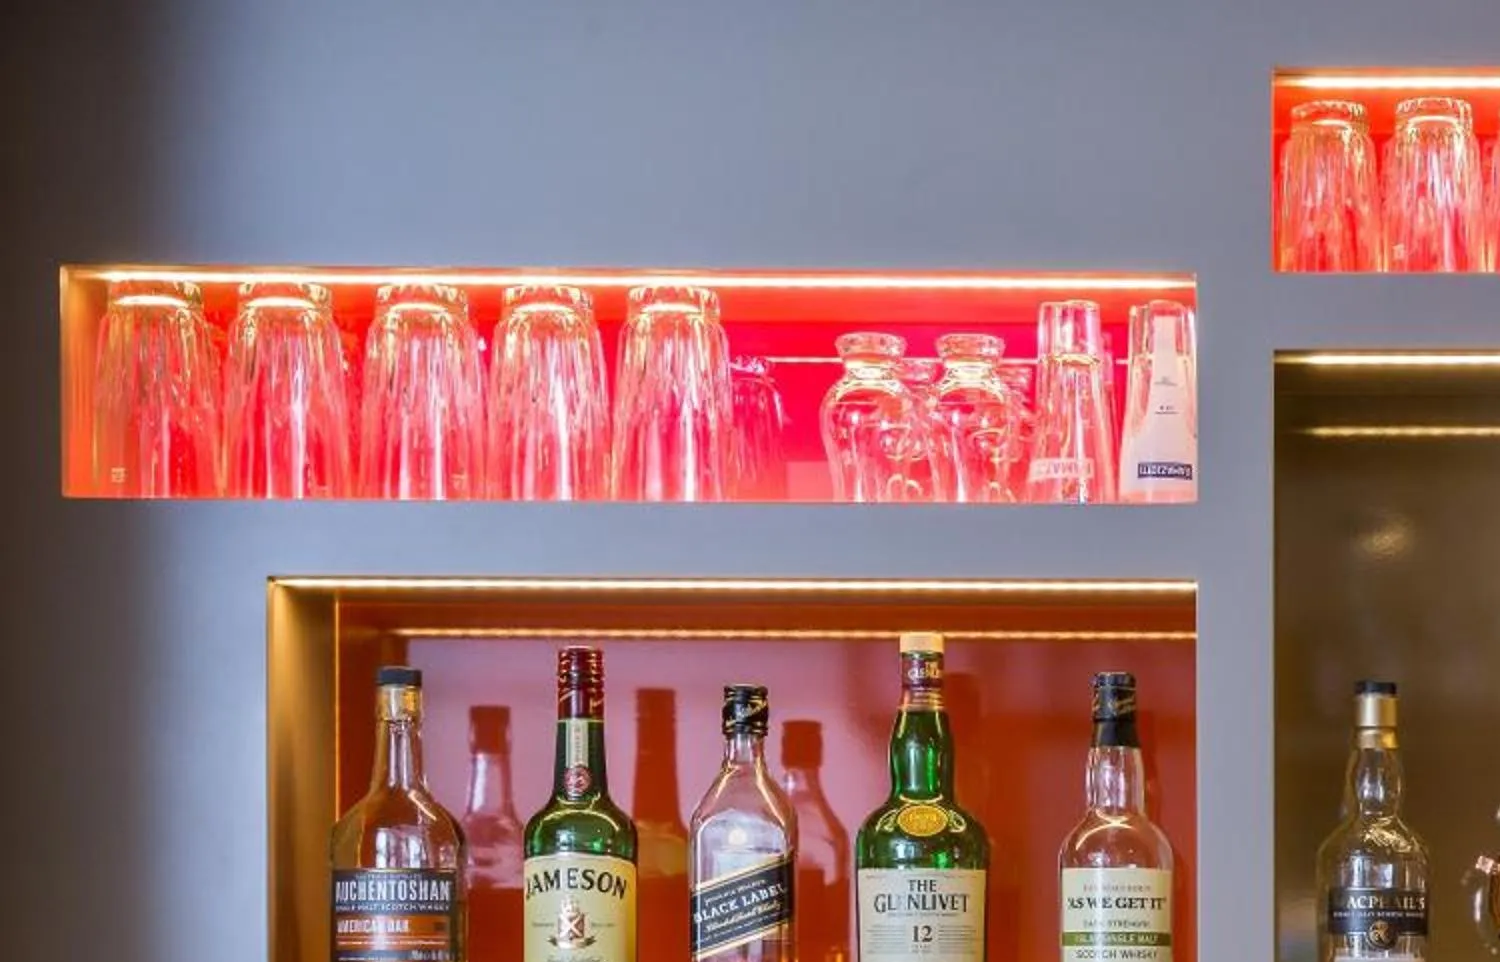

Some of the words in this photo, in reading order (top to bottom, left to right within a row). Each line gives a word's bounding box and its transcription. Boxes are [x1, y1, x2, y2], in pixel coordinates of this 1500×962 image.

[526, 868, 627, 900] JAMESON
[908, 879, 937, 892] THE
[693, 899, 739, 922] BLACK
[742, 883, 786, 907] LABEL
[873, 894, 970, 914] GLENLIVET
[1115, 897, 1149, 909] GET
[913, 926, 933, 943] 12
